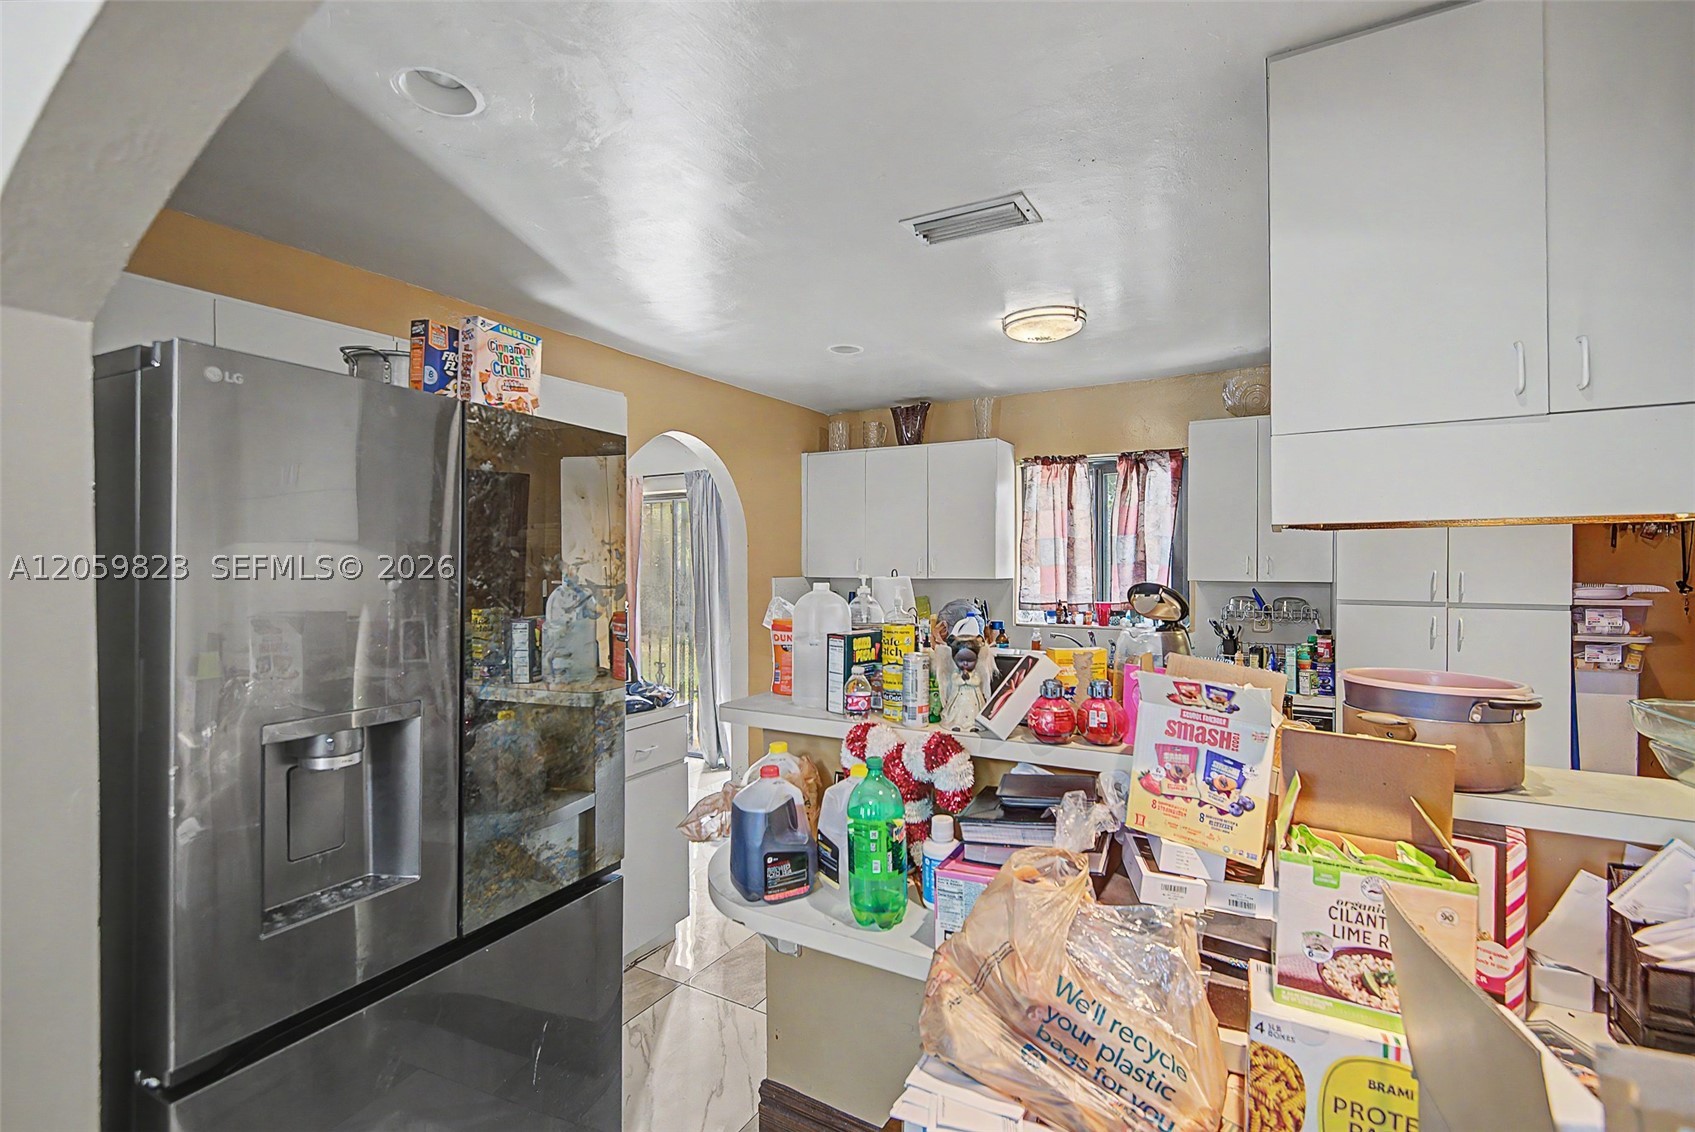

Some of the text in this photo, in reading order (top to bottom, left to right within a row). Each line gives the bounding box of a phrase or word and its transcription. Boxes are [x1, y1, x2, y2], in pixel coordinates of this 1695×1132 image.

[490, 339, 531, 356] Cinnamon
[498, 351, 524, 366] Toast
[225, 371, 244, 384] LG
[493, 361, 531, 378] Crunch
[1199, 812, 1205, 823] 8
[1332, 924, 1371, 945] LIME
[1055, 975, 1187, 1082] We'll recycle
[1255, 1022, 1264, 1034] 4
[1042, 1004, 1176, 1101] your plastic
[1036, 1024, 1090, 1071] bags
[1093, 1066, 1128, 1095] for
[1131, 1094, 1176, 1132] you
[1367, 1079, 1414, 1100] BRAMI
